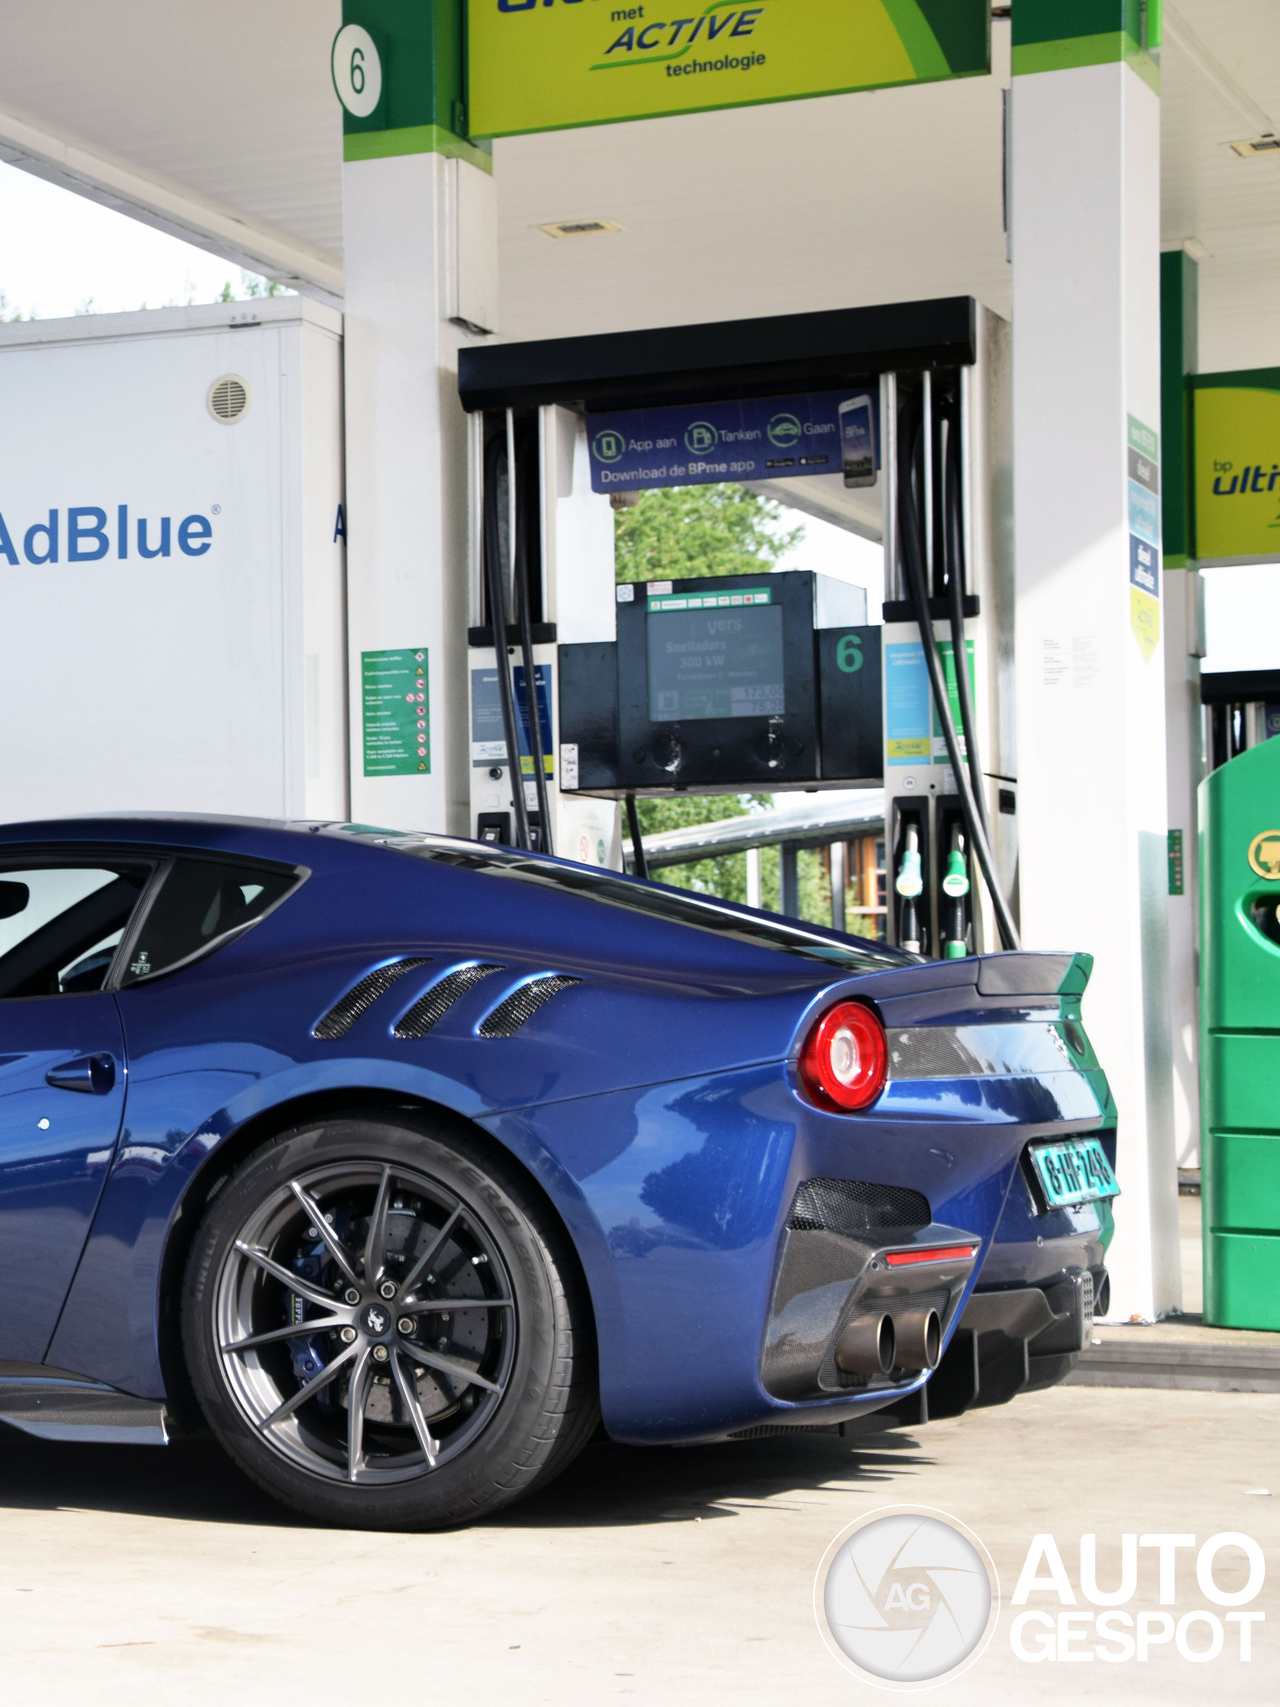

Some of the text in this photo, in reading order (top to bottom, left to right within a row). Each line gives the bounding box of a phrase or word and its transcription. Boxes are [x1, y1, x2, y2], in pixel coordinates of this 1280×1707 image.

[611, 5, 644, 22] met
[604, 8, 765, 55] ACTIVE
[350, 47, 365, 94] 6
[666, 51, 766, 77] technologie
[720, 429, 761, 442] Tanken
[803, 422, 835, 434] Gaan
[628, 437, 677, 452] App aan
[601, 460, 755, 483] Download de BPme app
[1214, 459, 1233, 473] bp
[1213, 464, 1280, 495] ulti
[680, 655, 724, 669] 300 kW
[836, 634, 863, 673] 6
